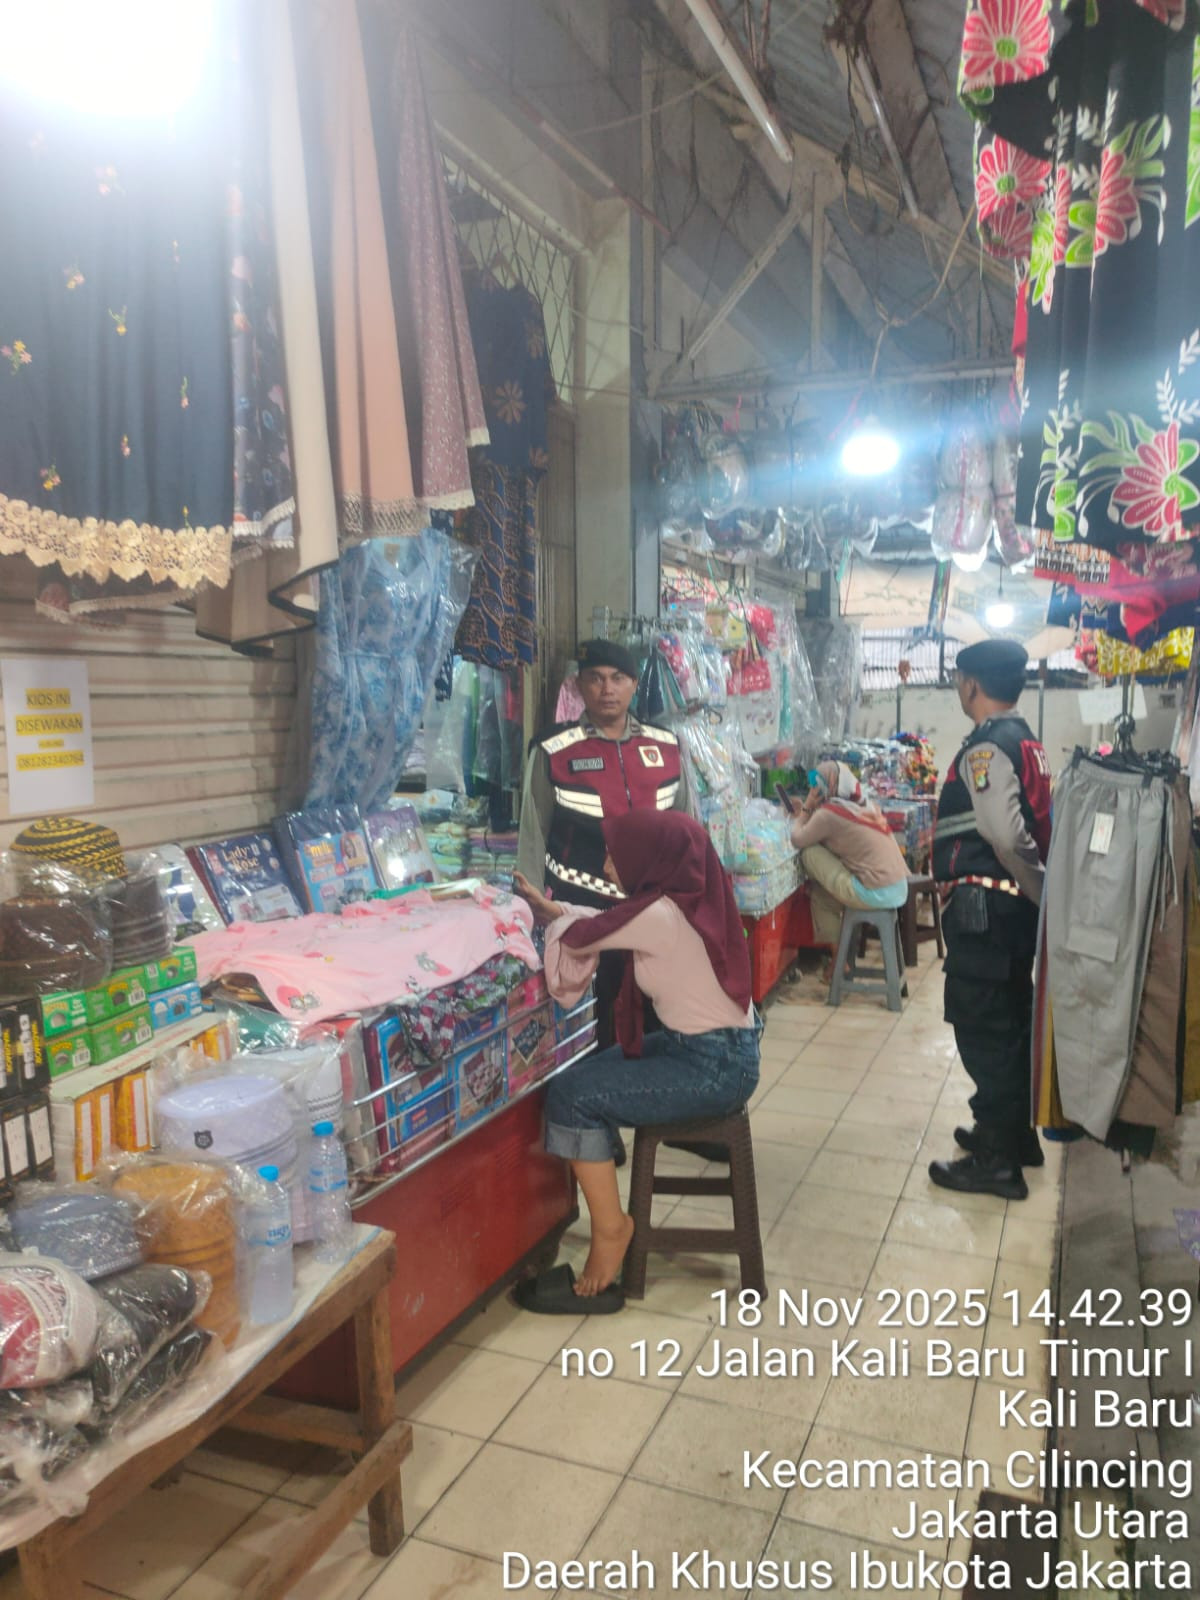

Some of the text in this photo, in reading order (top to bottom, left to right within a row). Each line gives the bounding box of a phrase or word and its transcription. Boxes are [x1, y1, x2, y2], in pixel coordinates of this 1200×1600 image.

[26, 693, 71, 706] KIOS INI
[16, 717, 83, 732] DISEWAKAN
[221, 846, 250, 862] Lady
